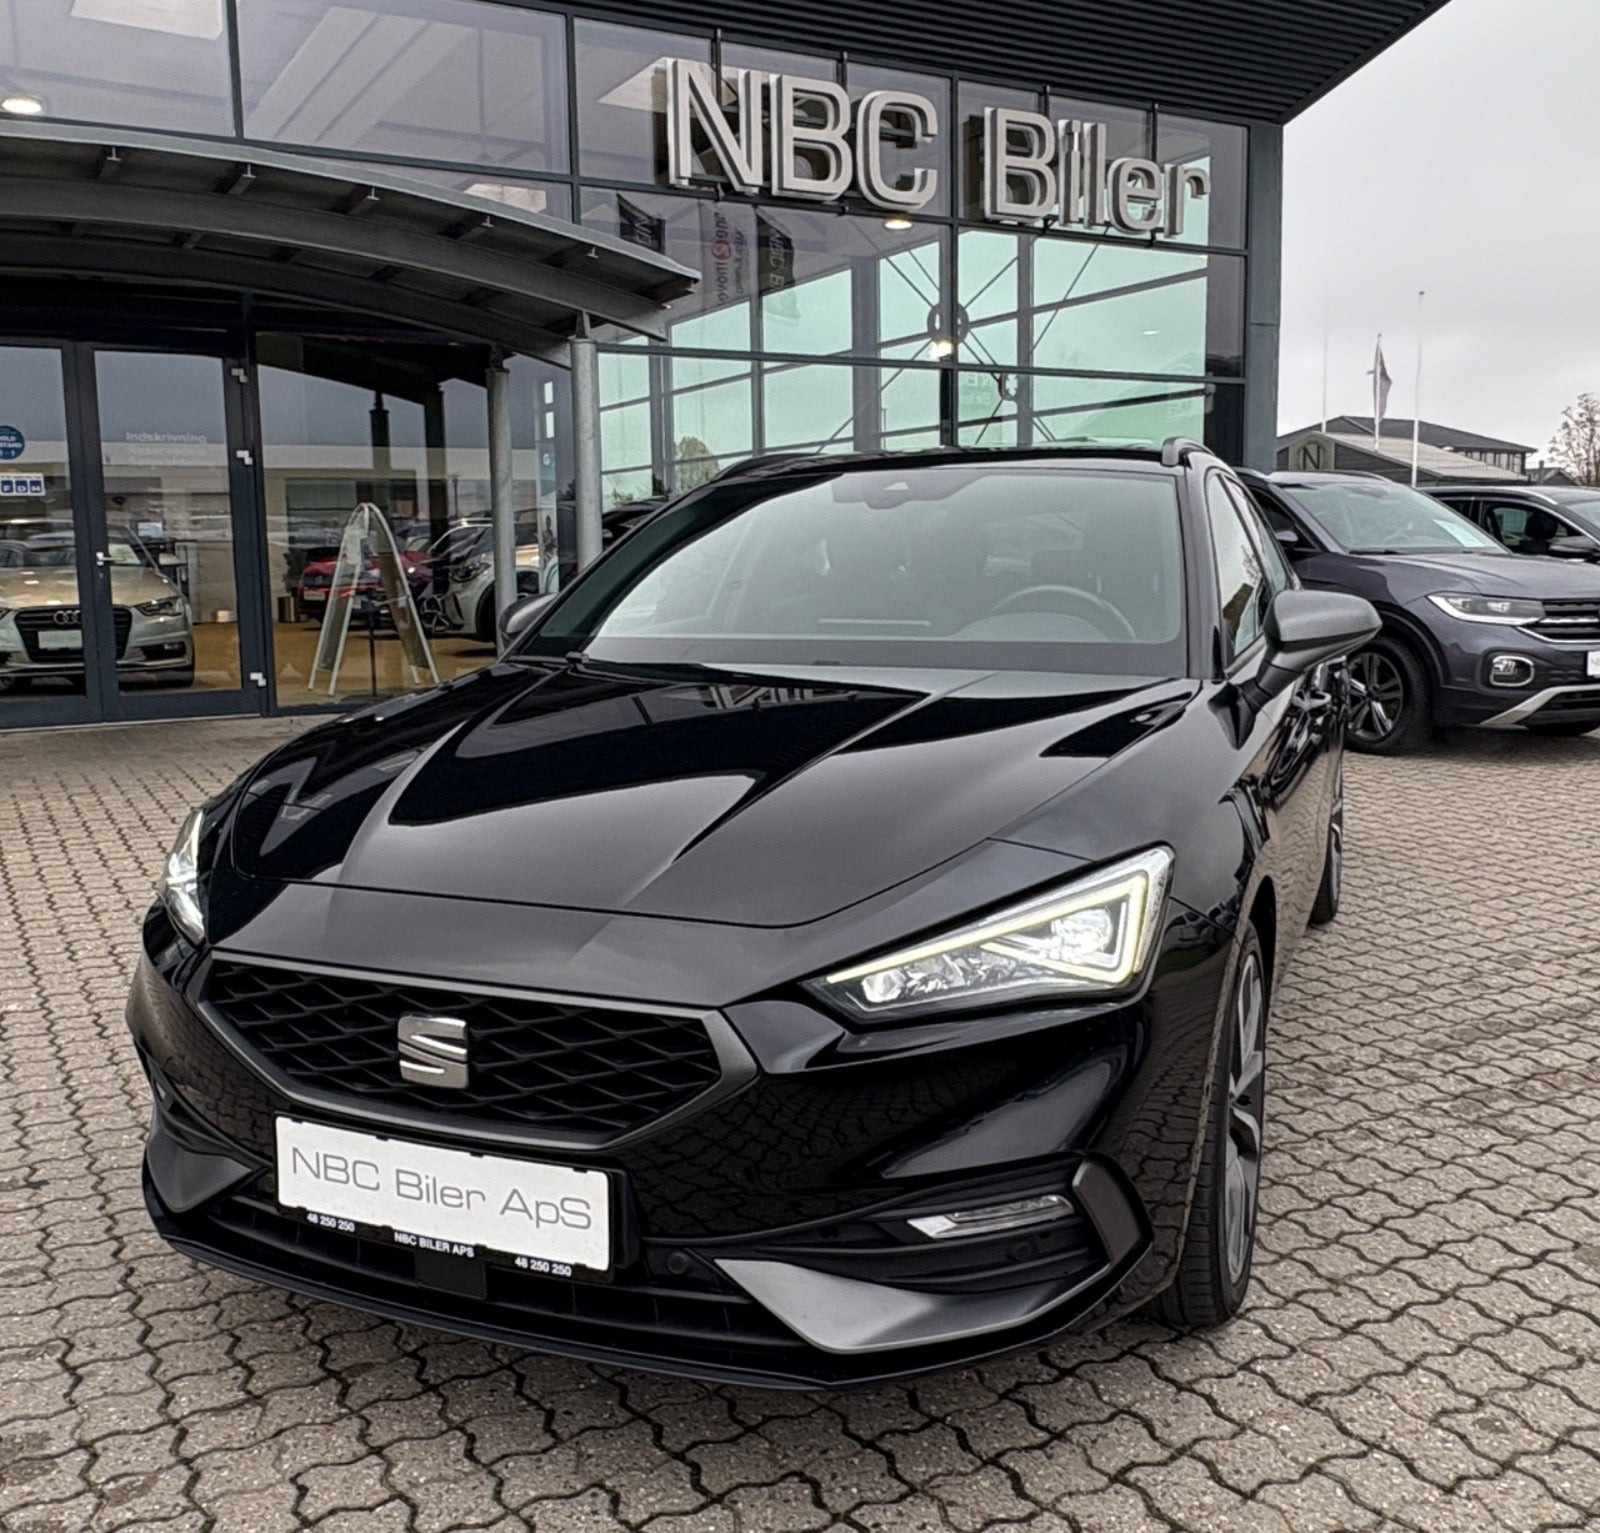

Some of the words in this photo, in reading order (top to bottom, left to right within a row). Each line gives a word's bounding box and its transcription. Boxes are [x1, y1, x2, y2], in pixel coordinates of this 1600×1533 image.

[666, 57, 938, 212] NBC
[984, 106, 1211, 238] Biler
[291, 1146, 381, 1192] NBC
[394, 1168, 487, 1210] Biler
[499, 1188, 592, 1230] ApS
[306, 1212, 319, 1225] 48
[319, 1215, 337, 1229] 250
[337, 1219, 356, 1233] 250
[394, 1231, 417, 1246] NBC
[418, 1235, 450, 1254] BILER
[451, 1244, 476, 1259] APS
[514, 1256, 529, 1269] 48
[529, 1259, 550, 1273] 250
[550, 1263, 573, 1278] 250
